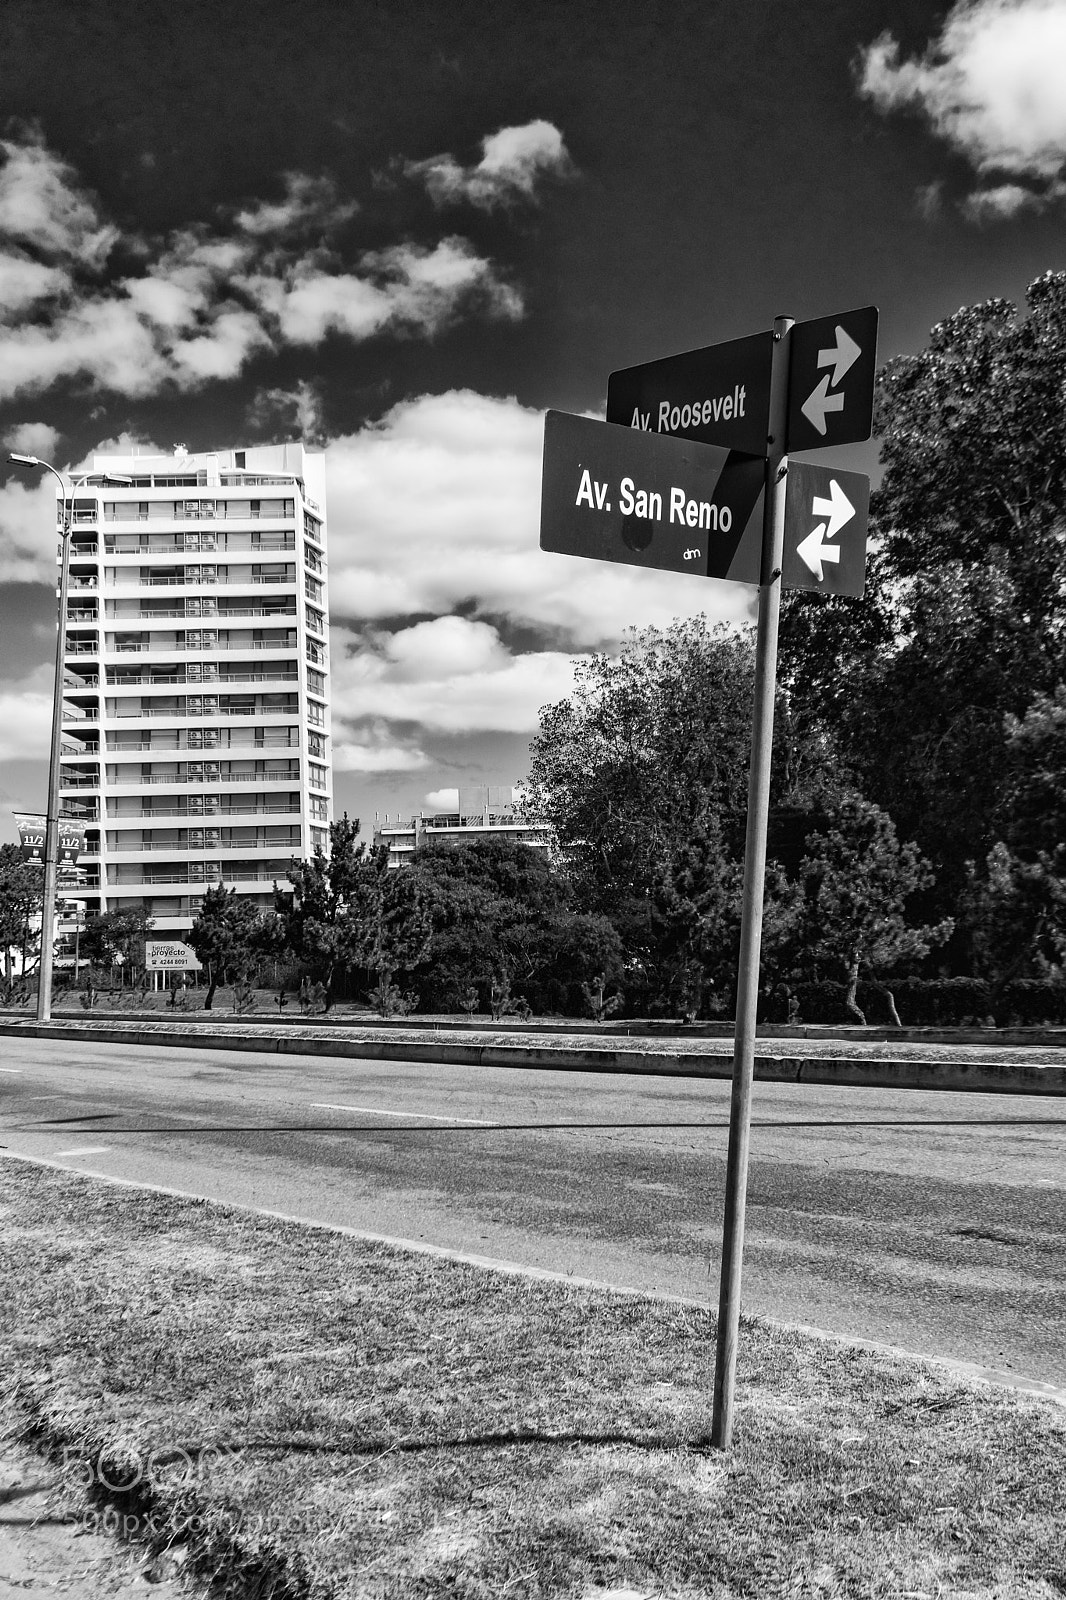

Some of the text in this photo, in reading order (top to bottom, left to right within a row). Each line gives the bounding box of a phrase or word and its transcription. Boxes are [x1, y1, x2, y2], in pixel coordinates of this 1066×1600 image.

[630, 384, 746, 433] Av. Roosevelt
[575, 469, 733, 533] Av. San Remo
[23, 834, 44, 845] 11/2
[61, 837, 80, 847] 11/2
[151, 949, 186, 957] proyecto
